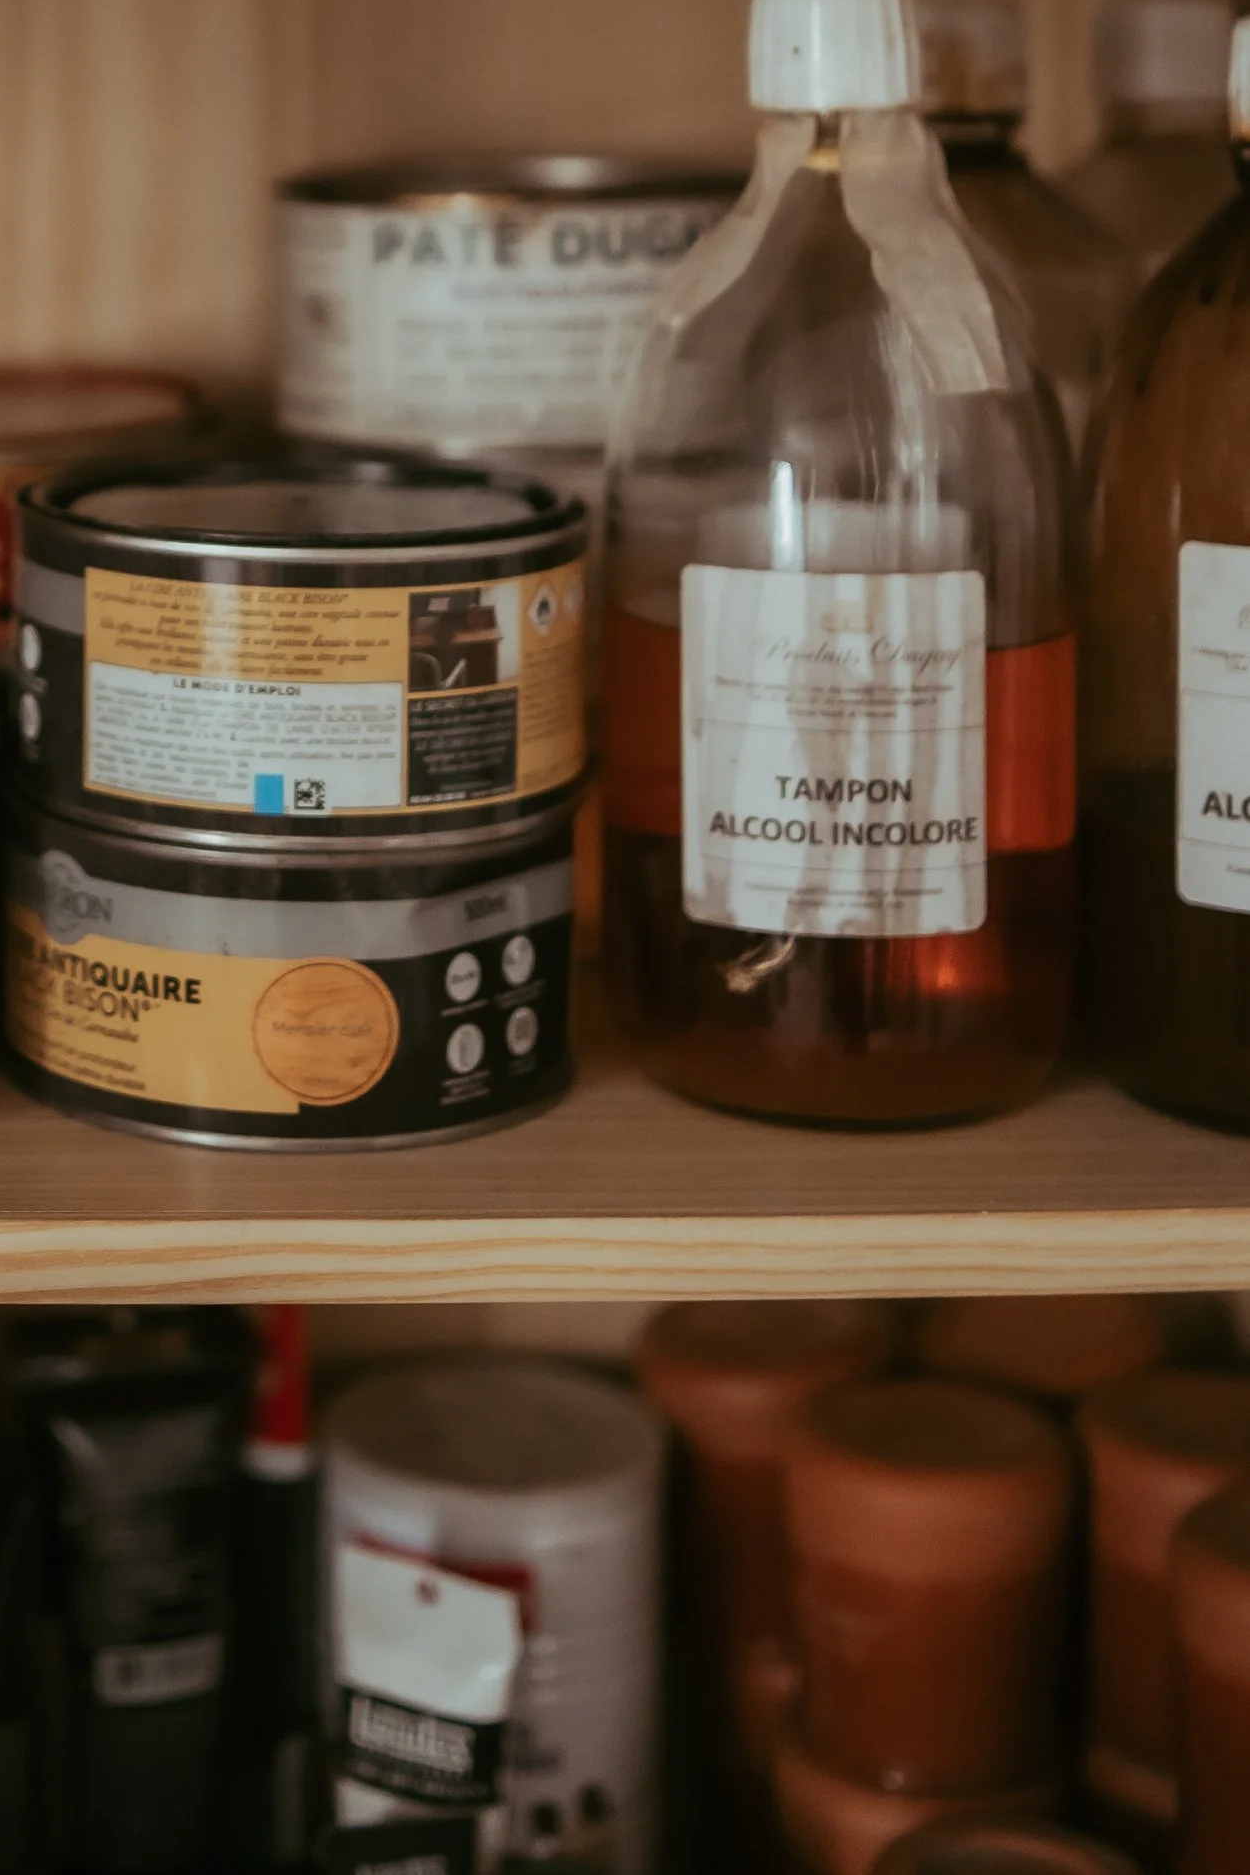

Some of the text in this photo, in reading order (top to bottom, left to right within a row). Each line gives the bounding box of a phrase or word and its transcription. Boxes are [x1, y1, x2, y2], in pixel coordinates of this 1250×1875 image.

[775, 774, 913, 804] TAMPON
[709, 810, 979, 848] ALCOOL INCOLORE
